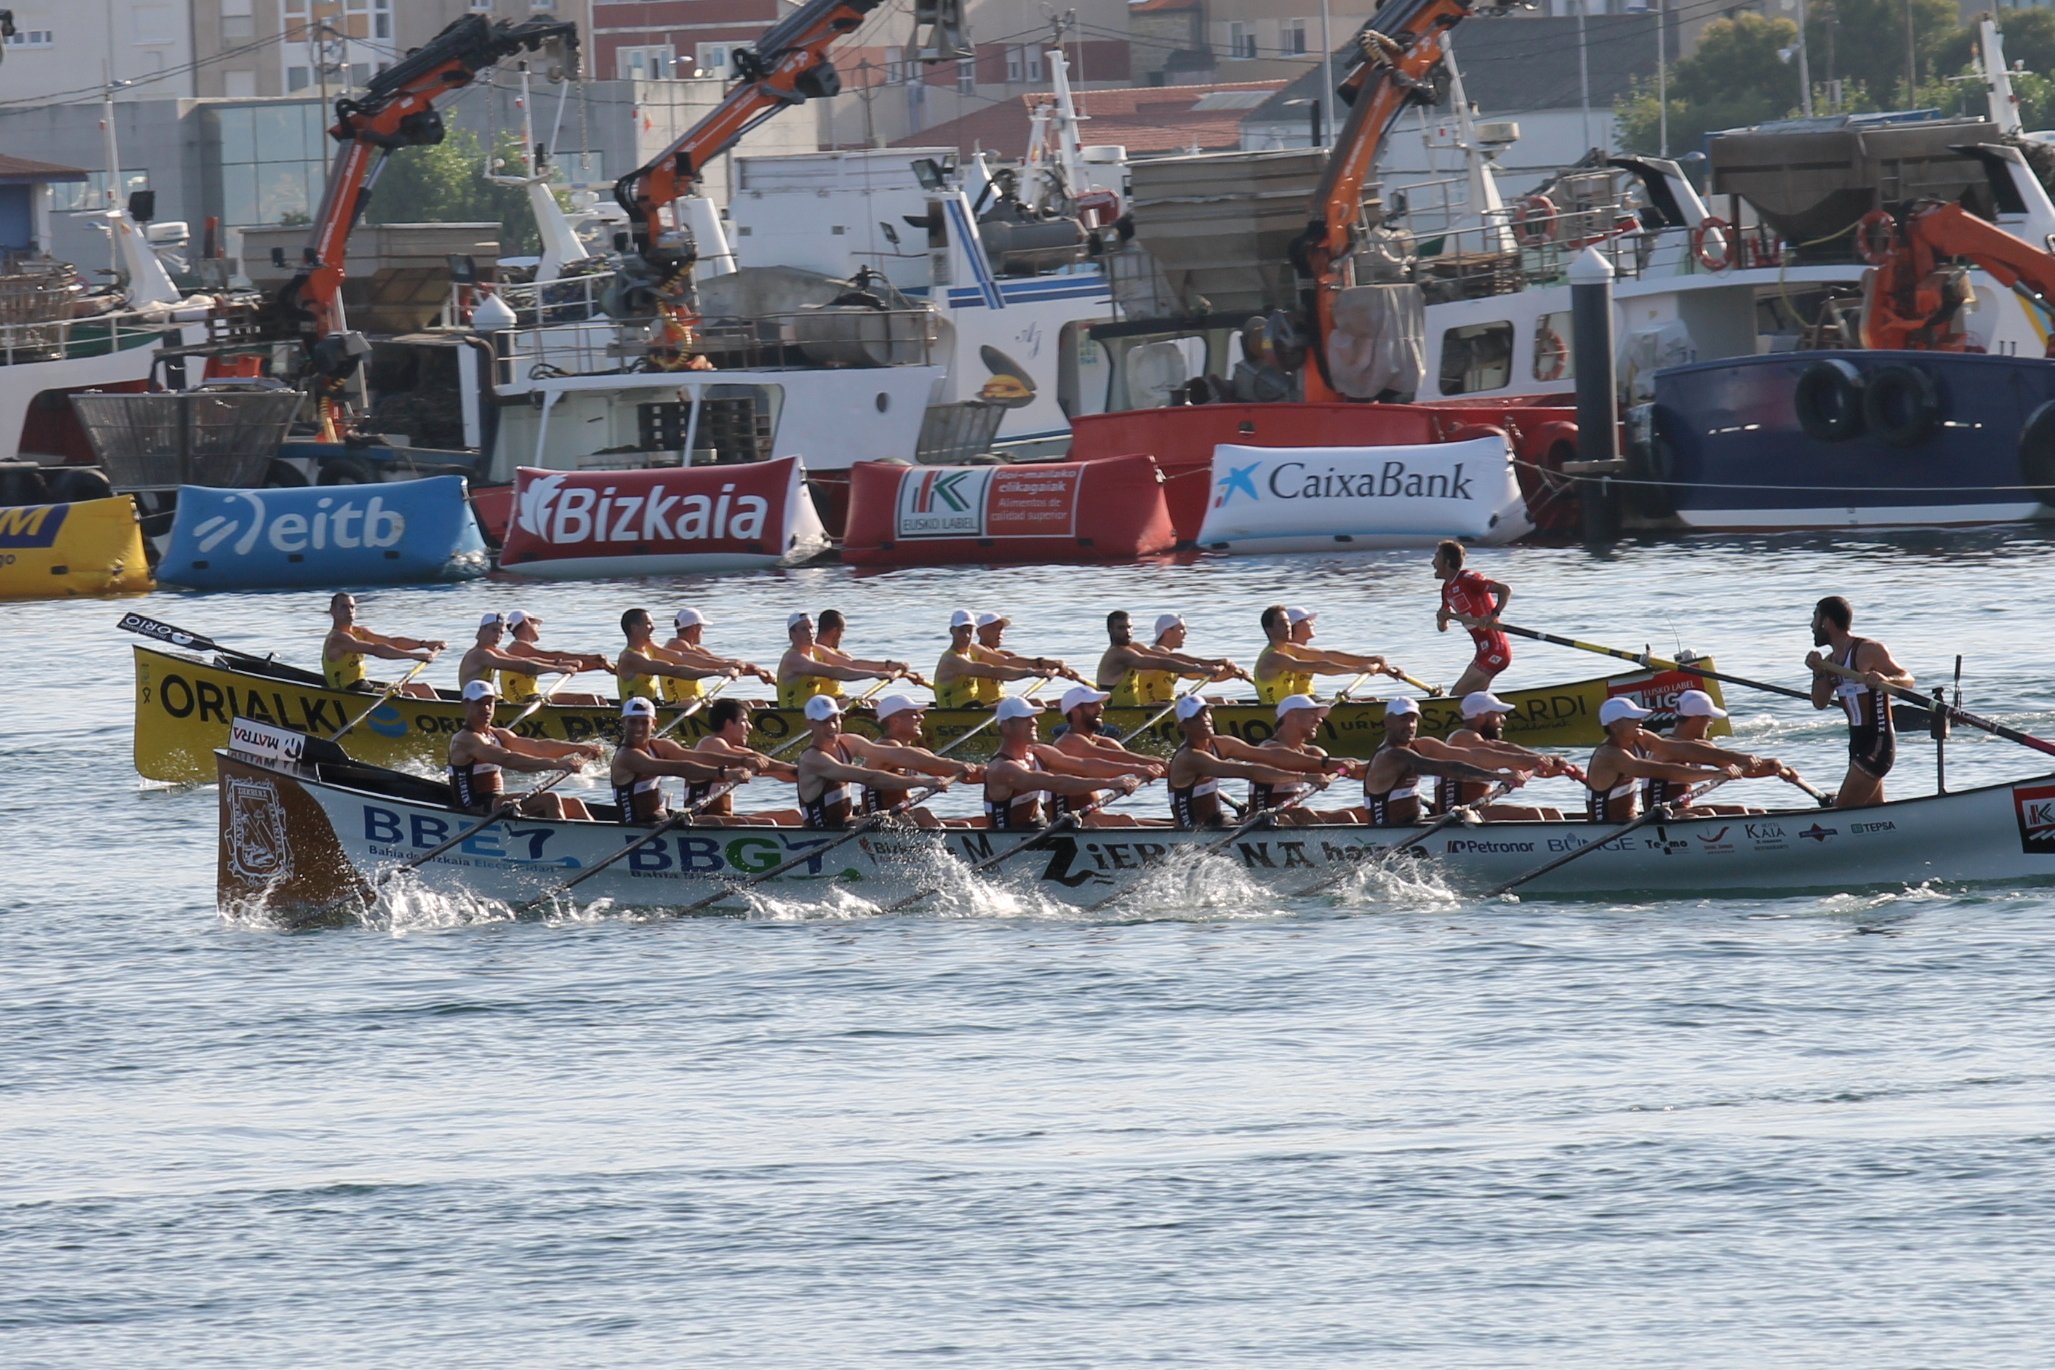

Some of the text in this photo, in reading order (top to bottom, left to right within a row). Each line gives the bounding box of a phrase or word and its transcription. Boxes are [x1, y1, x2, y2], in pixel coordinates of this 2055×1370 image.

[998, 481, 1066, 495] elikagaiak
[1268, 461, 1474, 500] CaixaBank
[998, 498, 1061, 507] Alimentos de
[0, 507, 54, 536] M
[553, 483, 768, 544] Bizkaia
[991, 510, 1067, 521] calidad superior
[269, 496, 405, 552] eitb
[903, 517, 977, 531] EUSKO LABEL
[126, 615, 171, 635] ORIO
[1643, 680, 1696, 697] EUSKO LABEL
[160, 674, 352, 735] ORIALKI
[1644, 692, 1681, 709] LIG
[1423, 695, 1587, 731] SAARDI
[1876, 690, 1886, 733] ZIERBEN
[233, 726, 280, 751] MATRA
[1744, 824, 1787, 839] KAIA
[1863, 821, 1897, 833] TEPSA
[1468, 840, 1535, 853] Petronor
[424, 855, 471, 867] izkaia
